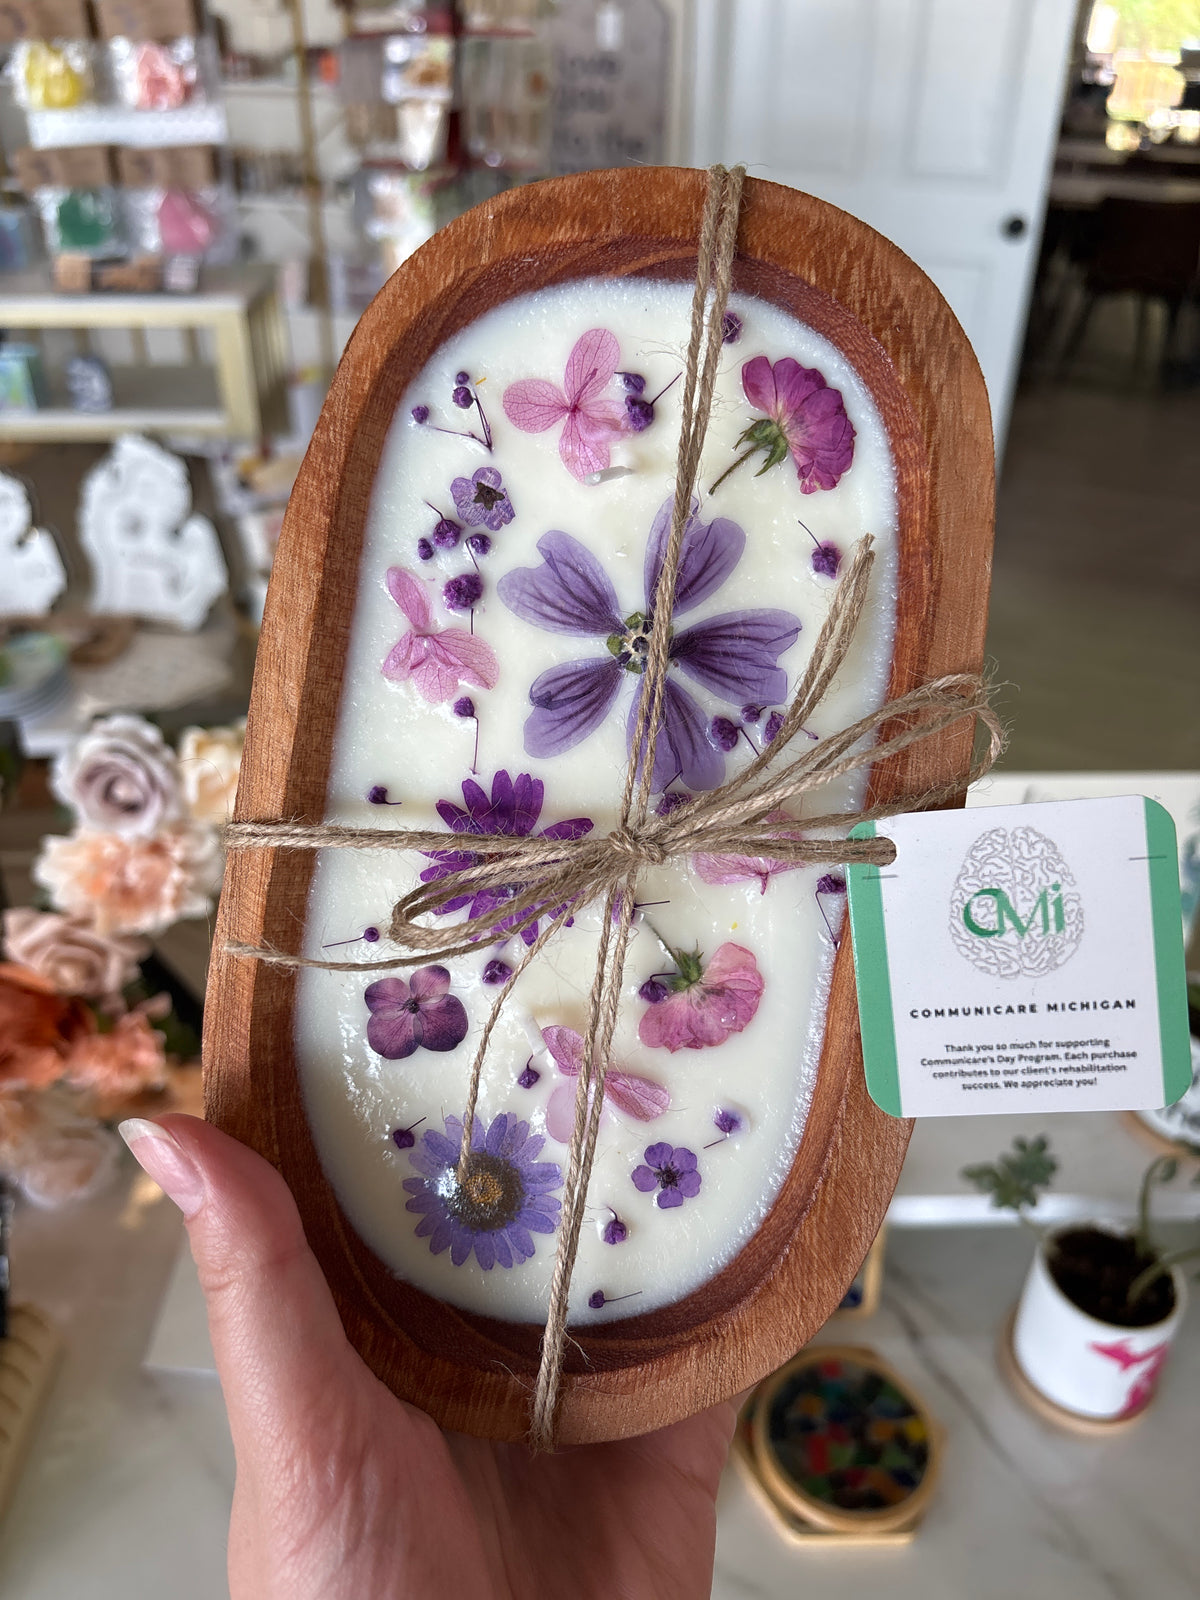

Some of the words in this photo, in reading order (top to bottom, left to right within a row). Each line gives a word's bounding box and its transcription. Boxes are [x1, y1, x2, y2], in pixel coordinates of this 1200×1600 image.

[910, 1003, 1038, 1019] COMMUNICARE
[1047, 1000, 1136, 1013] MICHIGAN
[944, 1044, 973, 1053] Thank
[976, 1044, 994, 1053] you
[996, 1043, 1007, 1051] so
[1009, 1041, 1036, 1050] much
[1038, 1040, 1053, 1048] for
[1055, 1038, 1110, 1048] supporting
[920, 1055, 995, 1066] Communicare's
[997, 1054, 1015, 1064] Day
[1018, 1052, 1062, 1063] Program.
[1064, 1051, 1088, 1060] Each
[1091, 1050, 1137, 1060] purchase
[932, 1068, 988, 1079] contributes
[990, 1068, 1000, 1076] to
[1003, 1067, 1018, 1075] our
[1021, 1065, 1056, 1075] client's
[1059, 1063, 1126, 1073] rehabilitation
[962, 1081, 1001, 1091] success.
[1003, 1080, 1018, 1089] We
[1021, 1078, 1073, 1089] appreciate
[1076, 1076, 1097, 1087] you!
